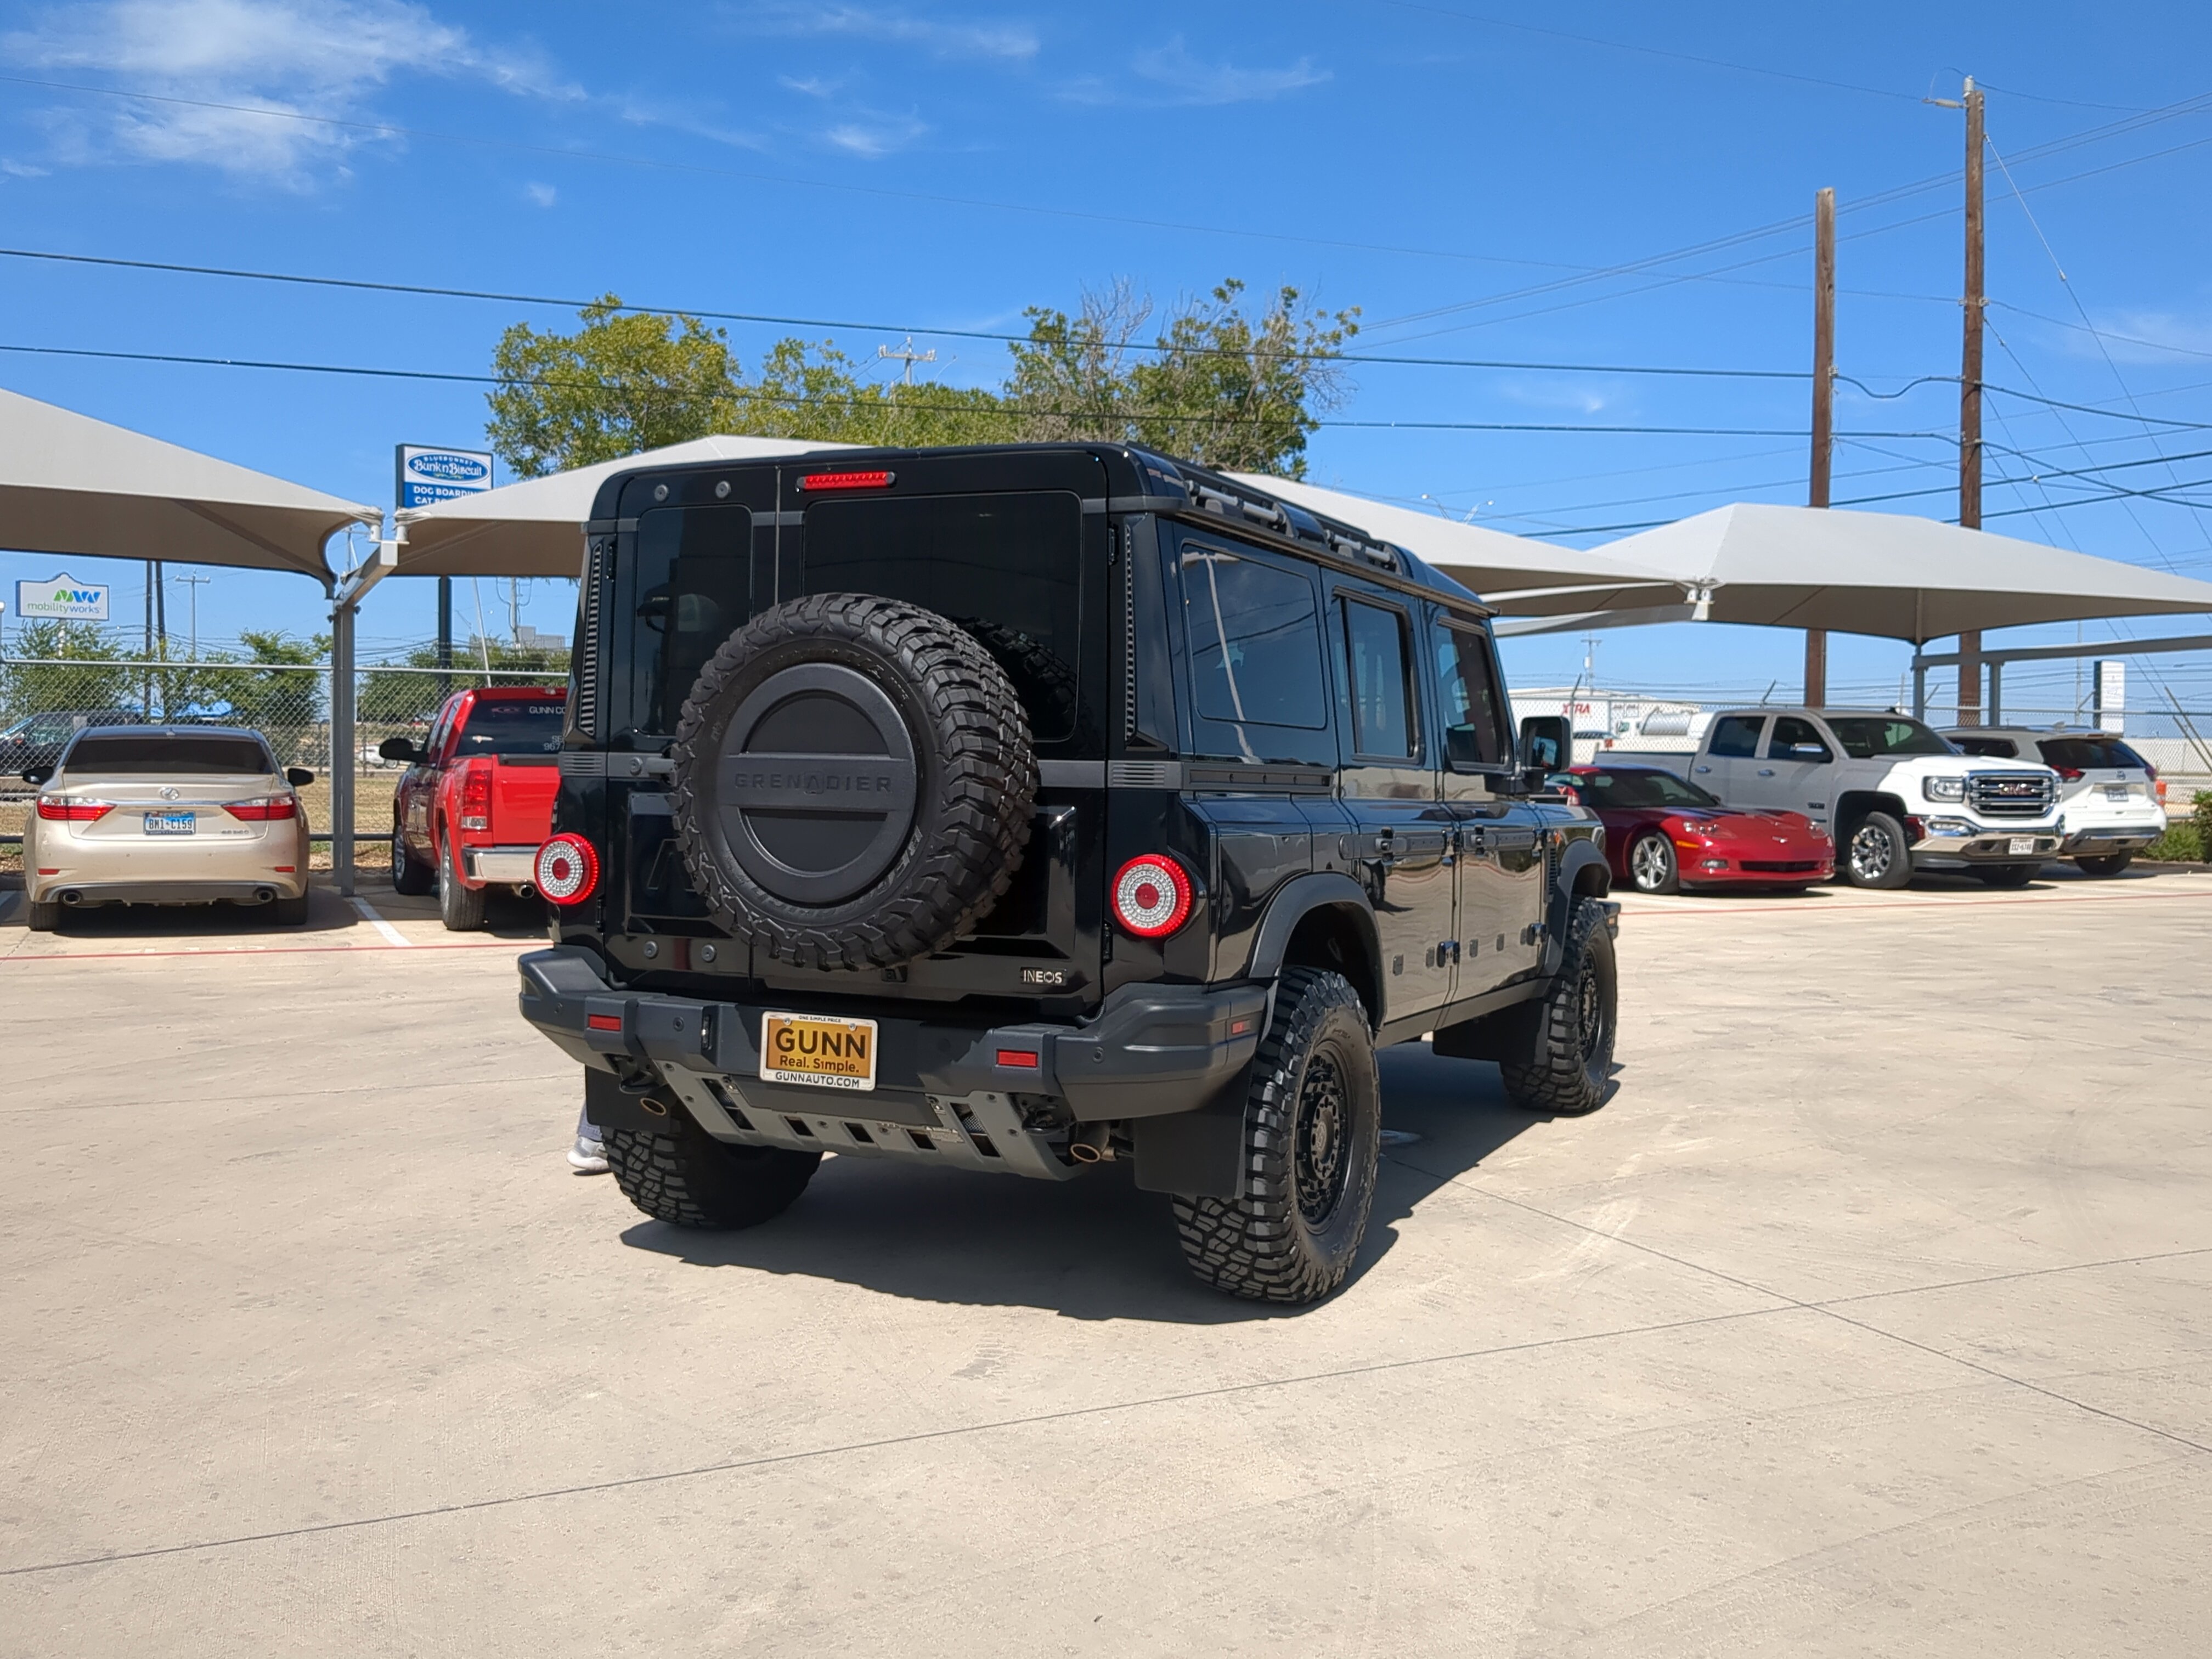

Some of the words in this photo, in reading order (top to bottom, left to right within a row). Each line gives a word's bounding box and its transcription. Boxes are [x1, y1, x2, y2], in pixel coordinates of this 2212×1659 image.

[424, 456, 473, 466] BLUEBONNET
[414, 486, 434, 495] DOG
[415, 496, 433, 504] CAT
[27, 602, 100, 614] mobilityworks
[529, 706, 554, 714] GUNN
[1561, 703, 1590, 714] XRA
[735, 772, 891, 792] GRENADIER
[1023, 969, 1062, 984] INEOS
[776, 1028, 866, 1059] GUNN
[780, 1055, 810, 1069] Real.
[776, 1071, 860, 1088] GUNNAUTO.COM
